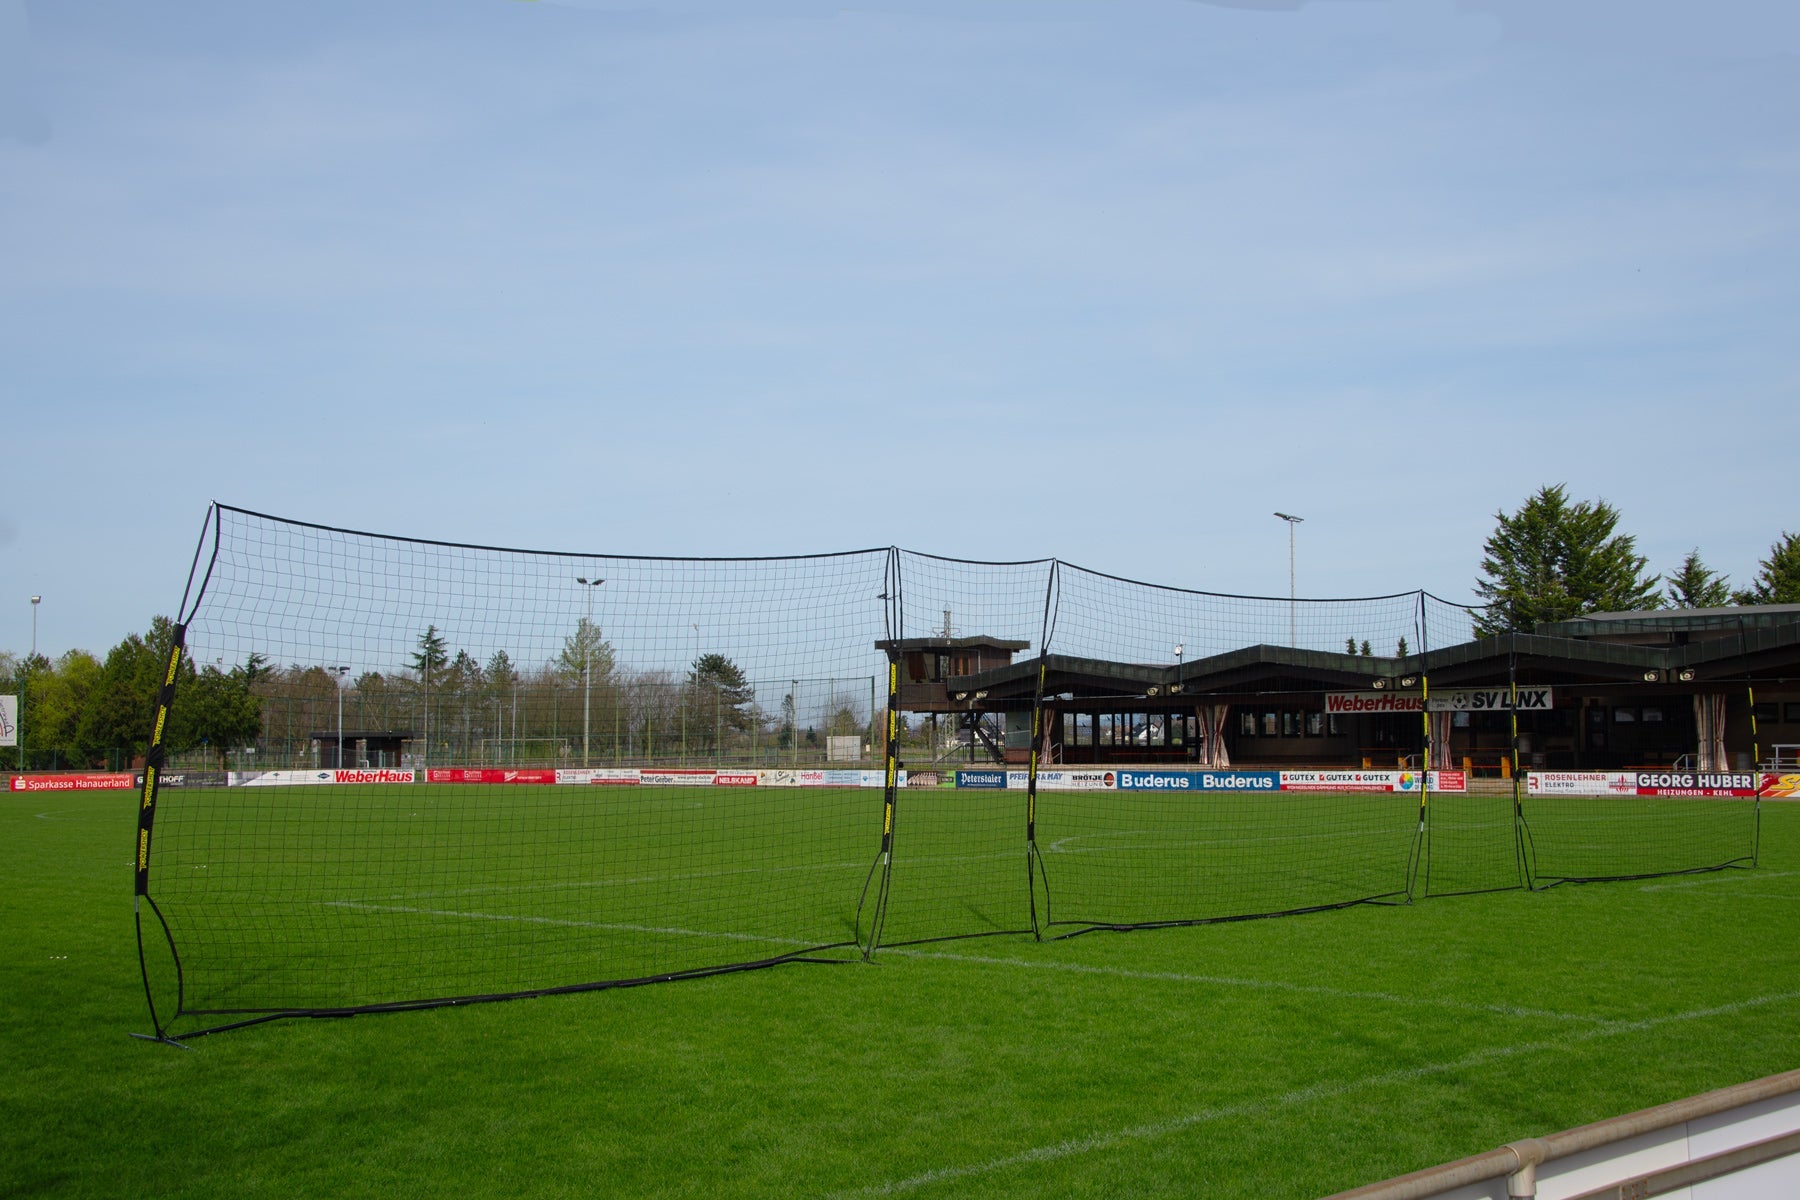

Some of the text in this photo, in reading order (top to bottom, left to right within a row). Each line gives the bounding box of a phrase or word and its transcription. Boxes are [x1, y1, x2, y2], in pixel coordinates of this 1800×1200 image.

[1327, 693, 1423, 712] WeberHaus
[1472, 691, 1498, 708] SV
[335, 770, 413, 783] WeberHaus
[655, 776, 674, 784] Gerber
[1047, 772, 1063, 780] MAY
[1122, 774, 1189, 787] Buderus
[1203, 774, 1273, 788] Buderus
[1638, 774, 1694, 787] GEORG
[1698, 774, 1751, 788] HUBER
[28, 779, 130, 790] Sparkasse Hanauerland
